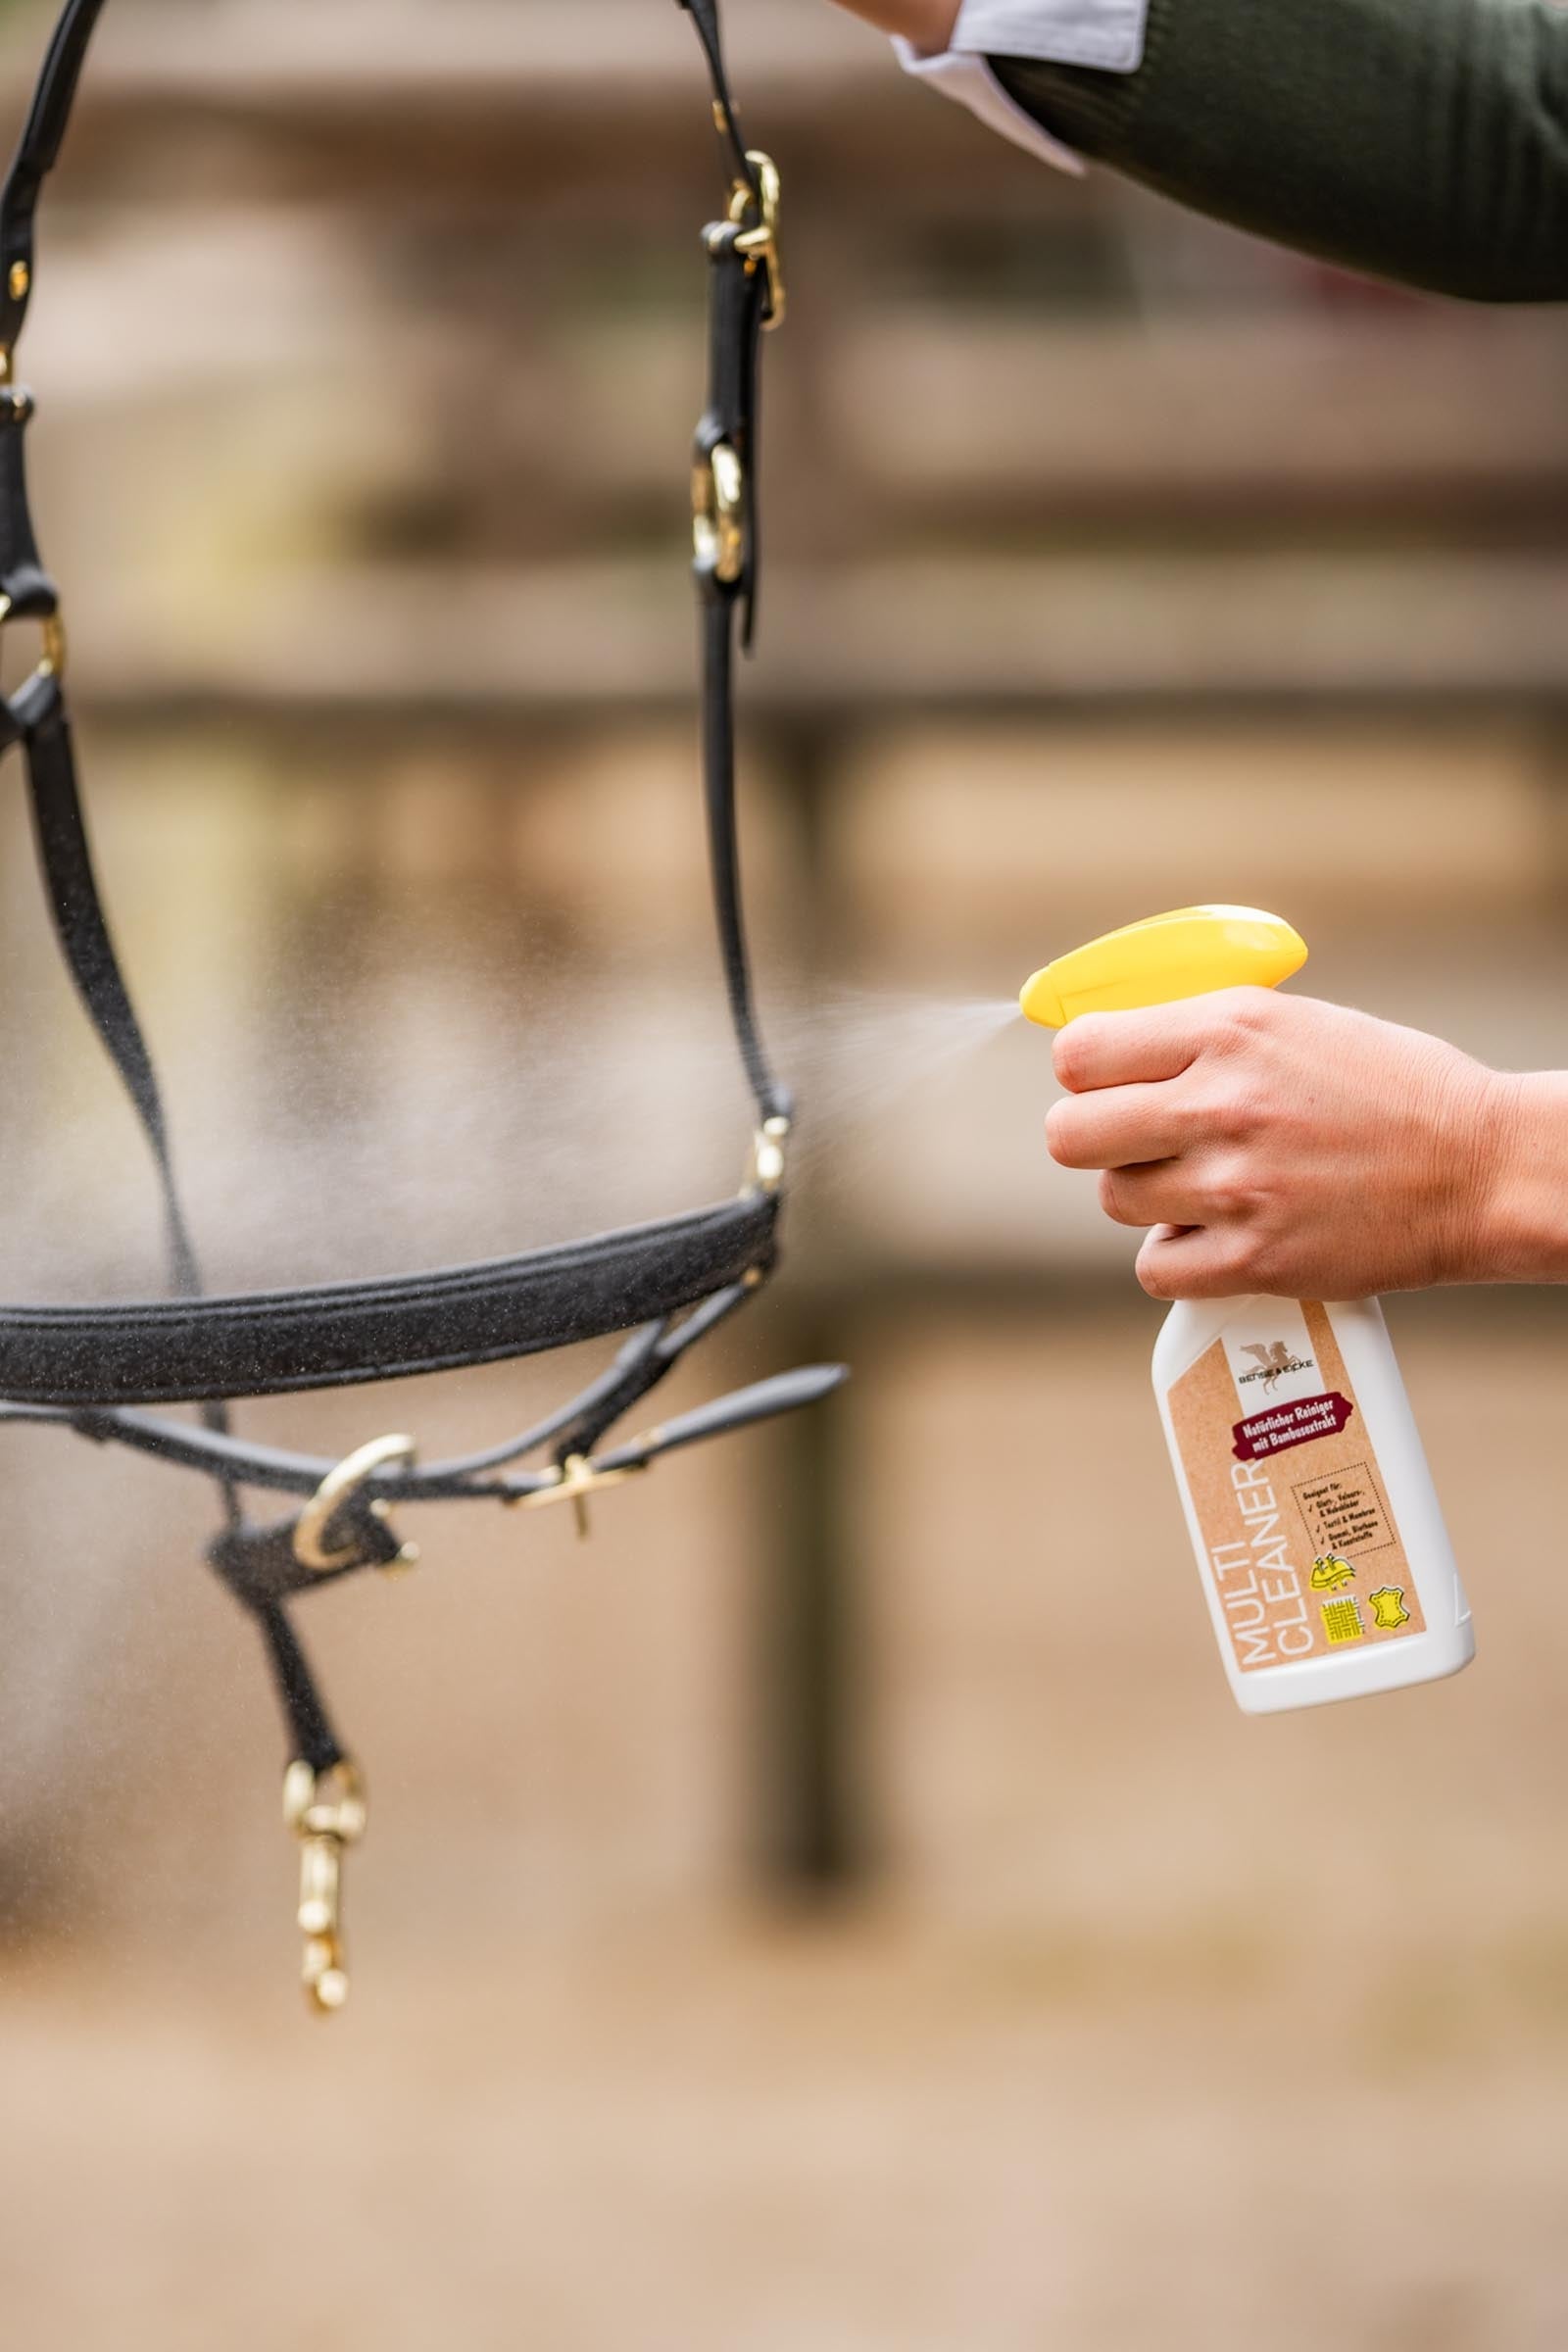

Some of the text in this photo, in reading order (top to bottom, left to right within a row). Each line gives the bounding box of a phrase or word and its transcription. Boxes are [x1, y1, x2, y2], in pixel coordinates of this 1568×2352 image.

[1242, 1399, 1334, 1439] Natürlicher Reiniger
[1252, 1414, 1337, 1452] mit Bambusextrakt
[1231, 1459, 1314, 1656] CLEANER
[1211, 1542, 1277, 1665] MULTI
